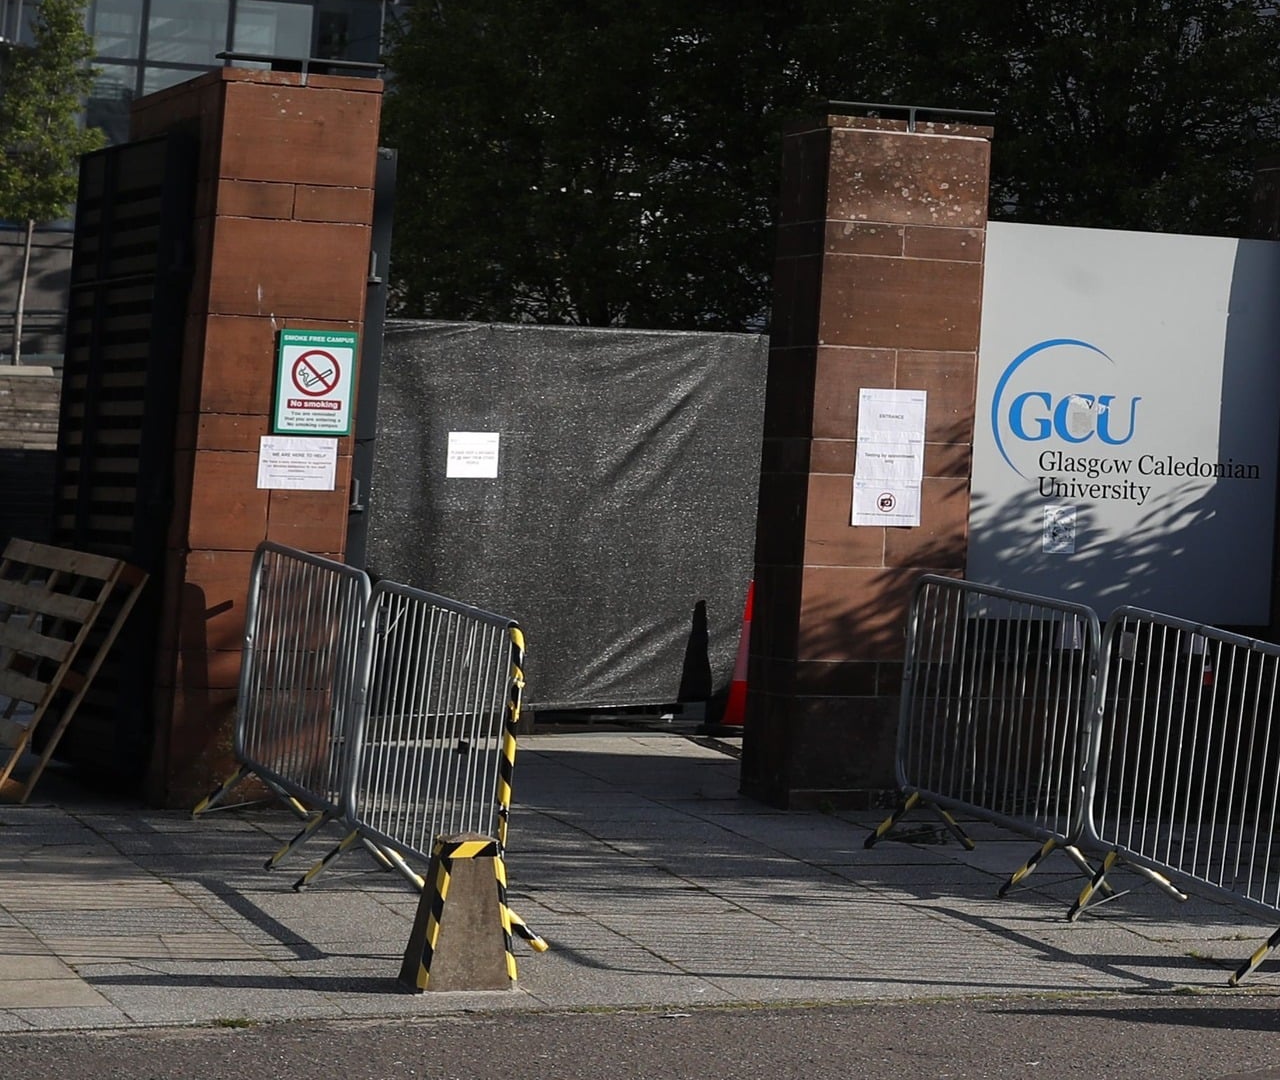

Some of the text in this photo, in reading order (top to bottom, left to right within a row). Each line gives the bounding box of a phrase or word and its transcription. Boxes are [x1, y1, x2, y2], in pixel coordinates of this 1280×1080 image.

[284, 334, 355, 344] SMOKE FREE CAMPUS
[303, 401, 338, 409] smoking
[1008, 391, 1142, 446] GCU
[1038, 450, 1260, 479] Glasgow Caledonian
[1038, 476, 1152, 506] University
